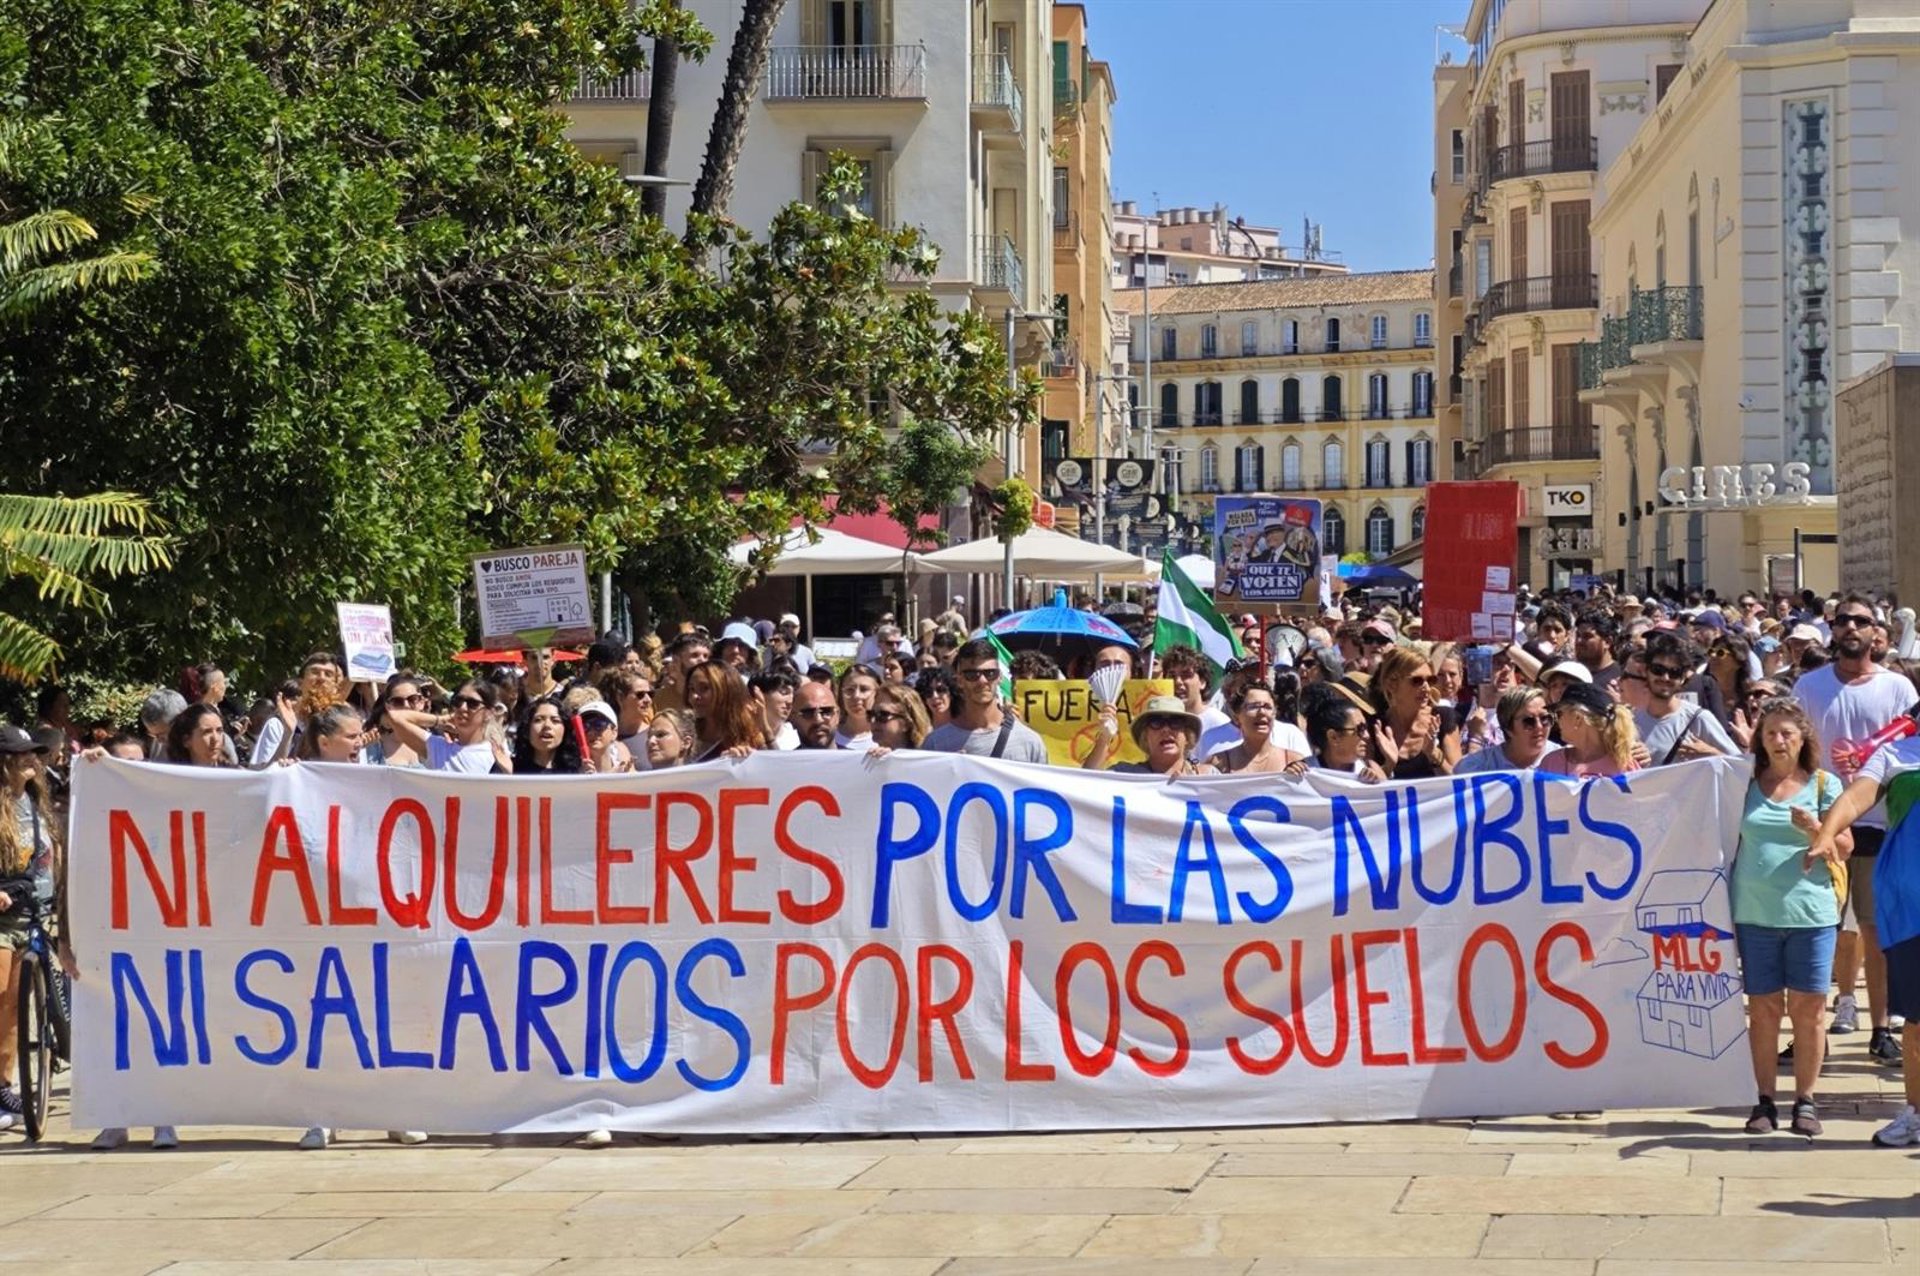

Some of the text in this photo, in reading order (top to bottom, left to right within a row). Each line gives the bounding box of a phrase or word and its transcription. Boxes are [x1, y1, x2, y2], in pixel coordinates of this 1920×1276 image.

[1659, 462, 1812, 502] CINES
[1548, 490, 1585, 505] TKO
[494, 553, 578, 572] BUSCO PAREJA
[1277, 566, 1293, 576] TE
[1241, 576, 1298, 588] VOTEN
[1264, 588, 1297, 596] GUIRIS
[1023, 689, 1132, 724] FUERA
[109, 769, 1642, 931] NI ALQUILERES POR LAS NUBES
[1652, 929, 1722, 973] MLG
[1656, 972, 1695, 1000] PARA
[111, 921, 1610, 1092] NI SALARIOS POR LOS SUELOS
